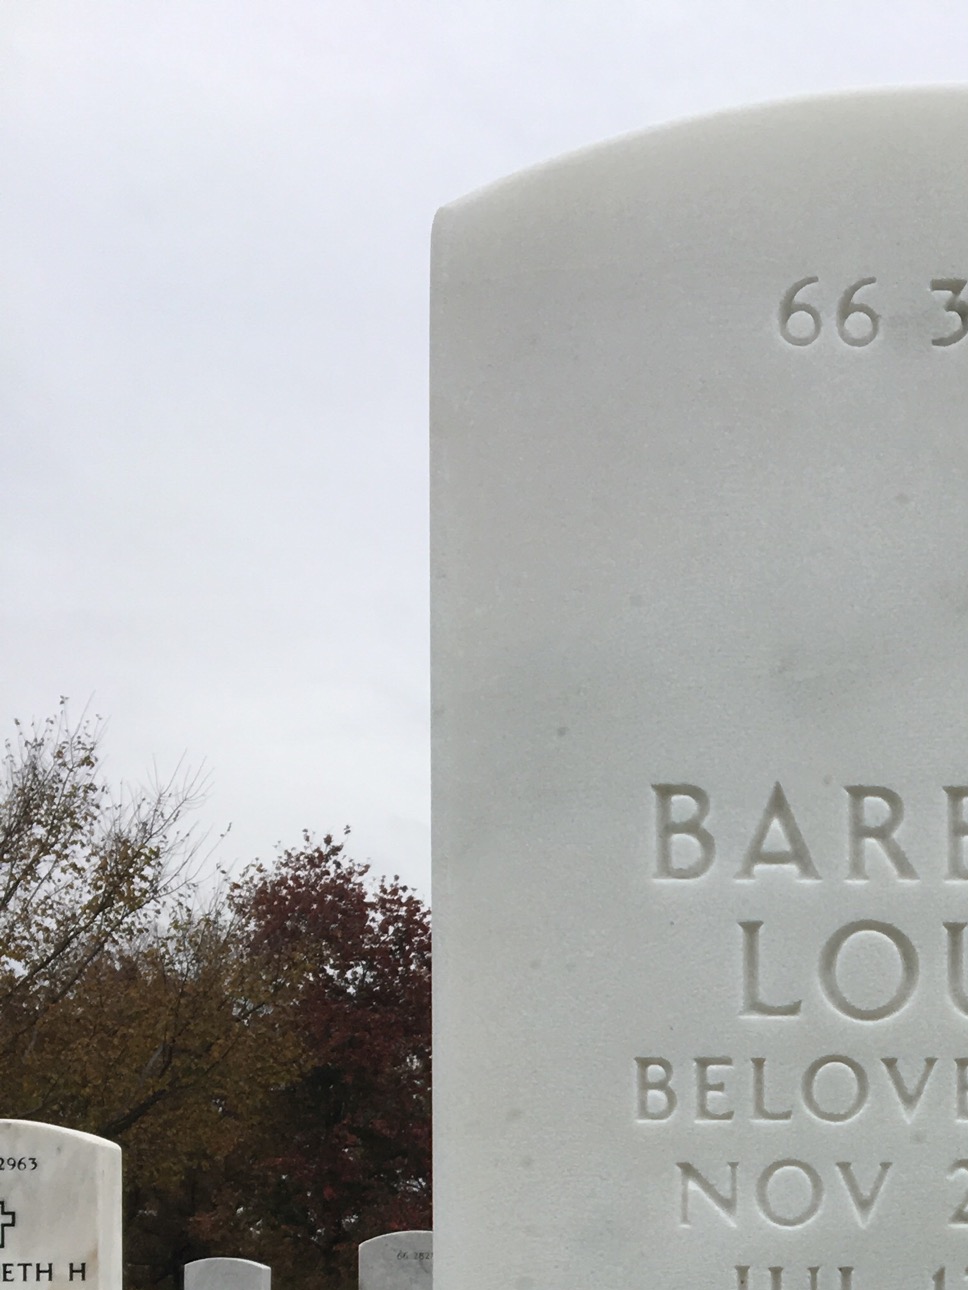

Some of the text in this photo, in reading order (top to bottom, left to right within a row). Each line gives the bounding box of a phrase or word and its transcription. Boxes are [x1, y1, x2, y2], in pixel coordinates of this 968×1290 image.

[779, 276, 880, 347] 66
[676, 1160, 892, 1227] NOV
[68, 1262, 86, 1282] H
